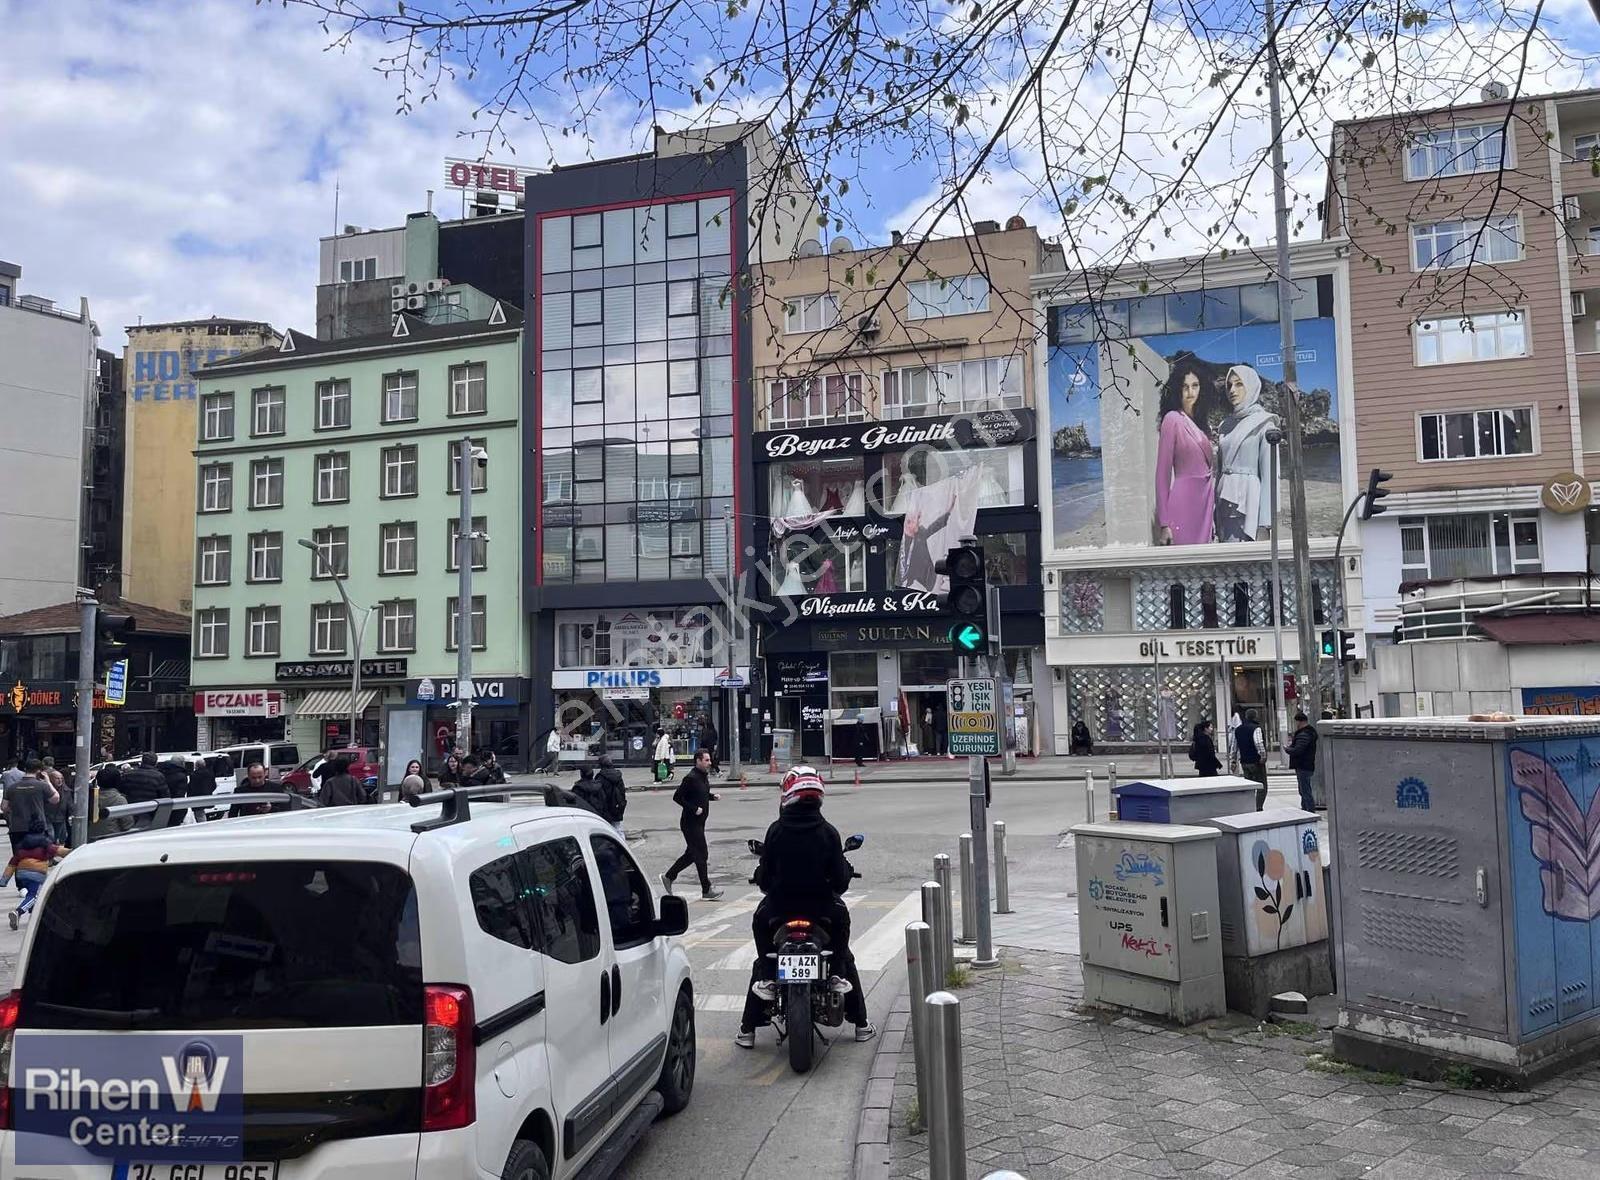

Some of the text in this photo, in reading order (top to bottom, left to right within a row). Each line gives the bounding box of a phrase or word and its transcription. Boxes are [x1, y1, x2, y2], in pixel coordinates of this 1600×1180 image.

[450, 162, 523, 193] OTEL
[765, 422, 956, 458] Beyaz Gelinlik
[801, 597, 876, 617] Nişanlık
[883, 598, 897, 611] &
[858, 625, 930, 642] SULTAN
[1139, 636, 1256, 657] GÜL TESETTÜR
[362, 661, 407, 676] OTEL
[587, 670, 661, 687] PHILIPS
[967, 681, 993, 692] YEŞİL
[30, 691, 60, 705] DÖNER
[207, 693, 263, 708] ECZANE
[953, 744, 995, 753] DURUNUZ
[1109, 921, 1133, 932] UPS
[780, 957, 817, 966] 41 AZK
[791, 969, 811, 978] 589
